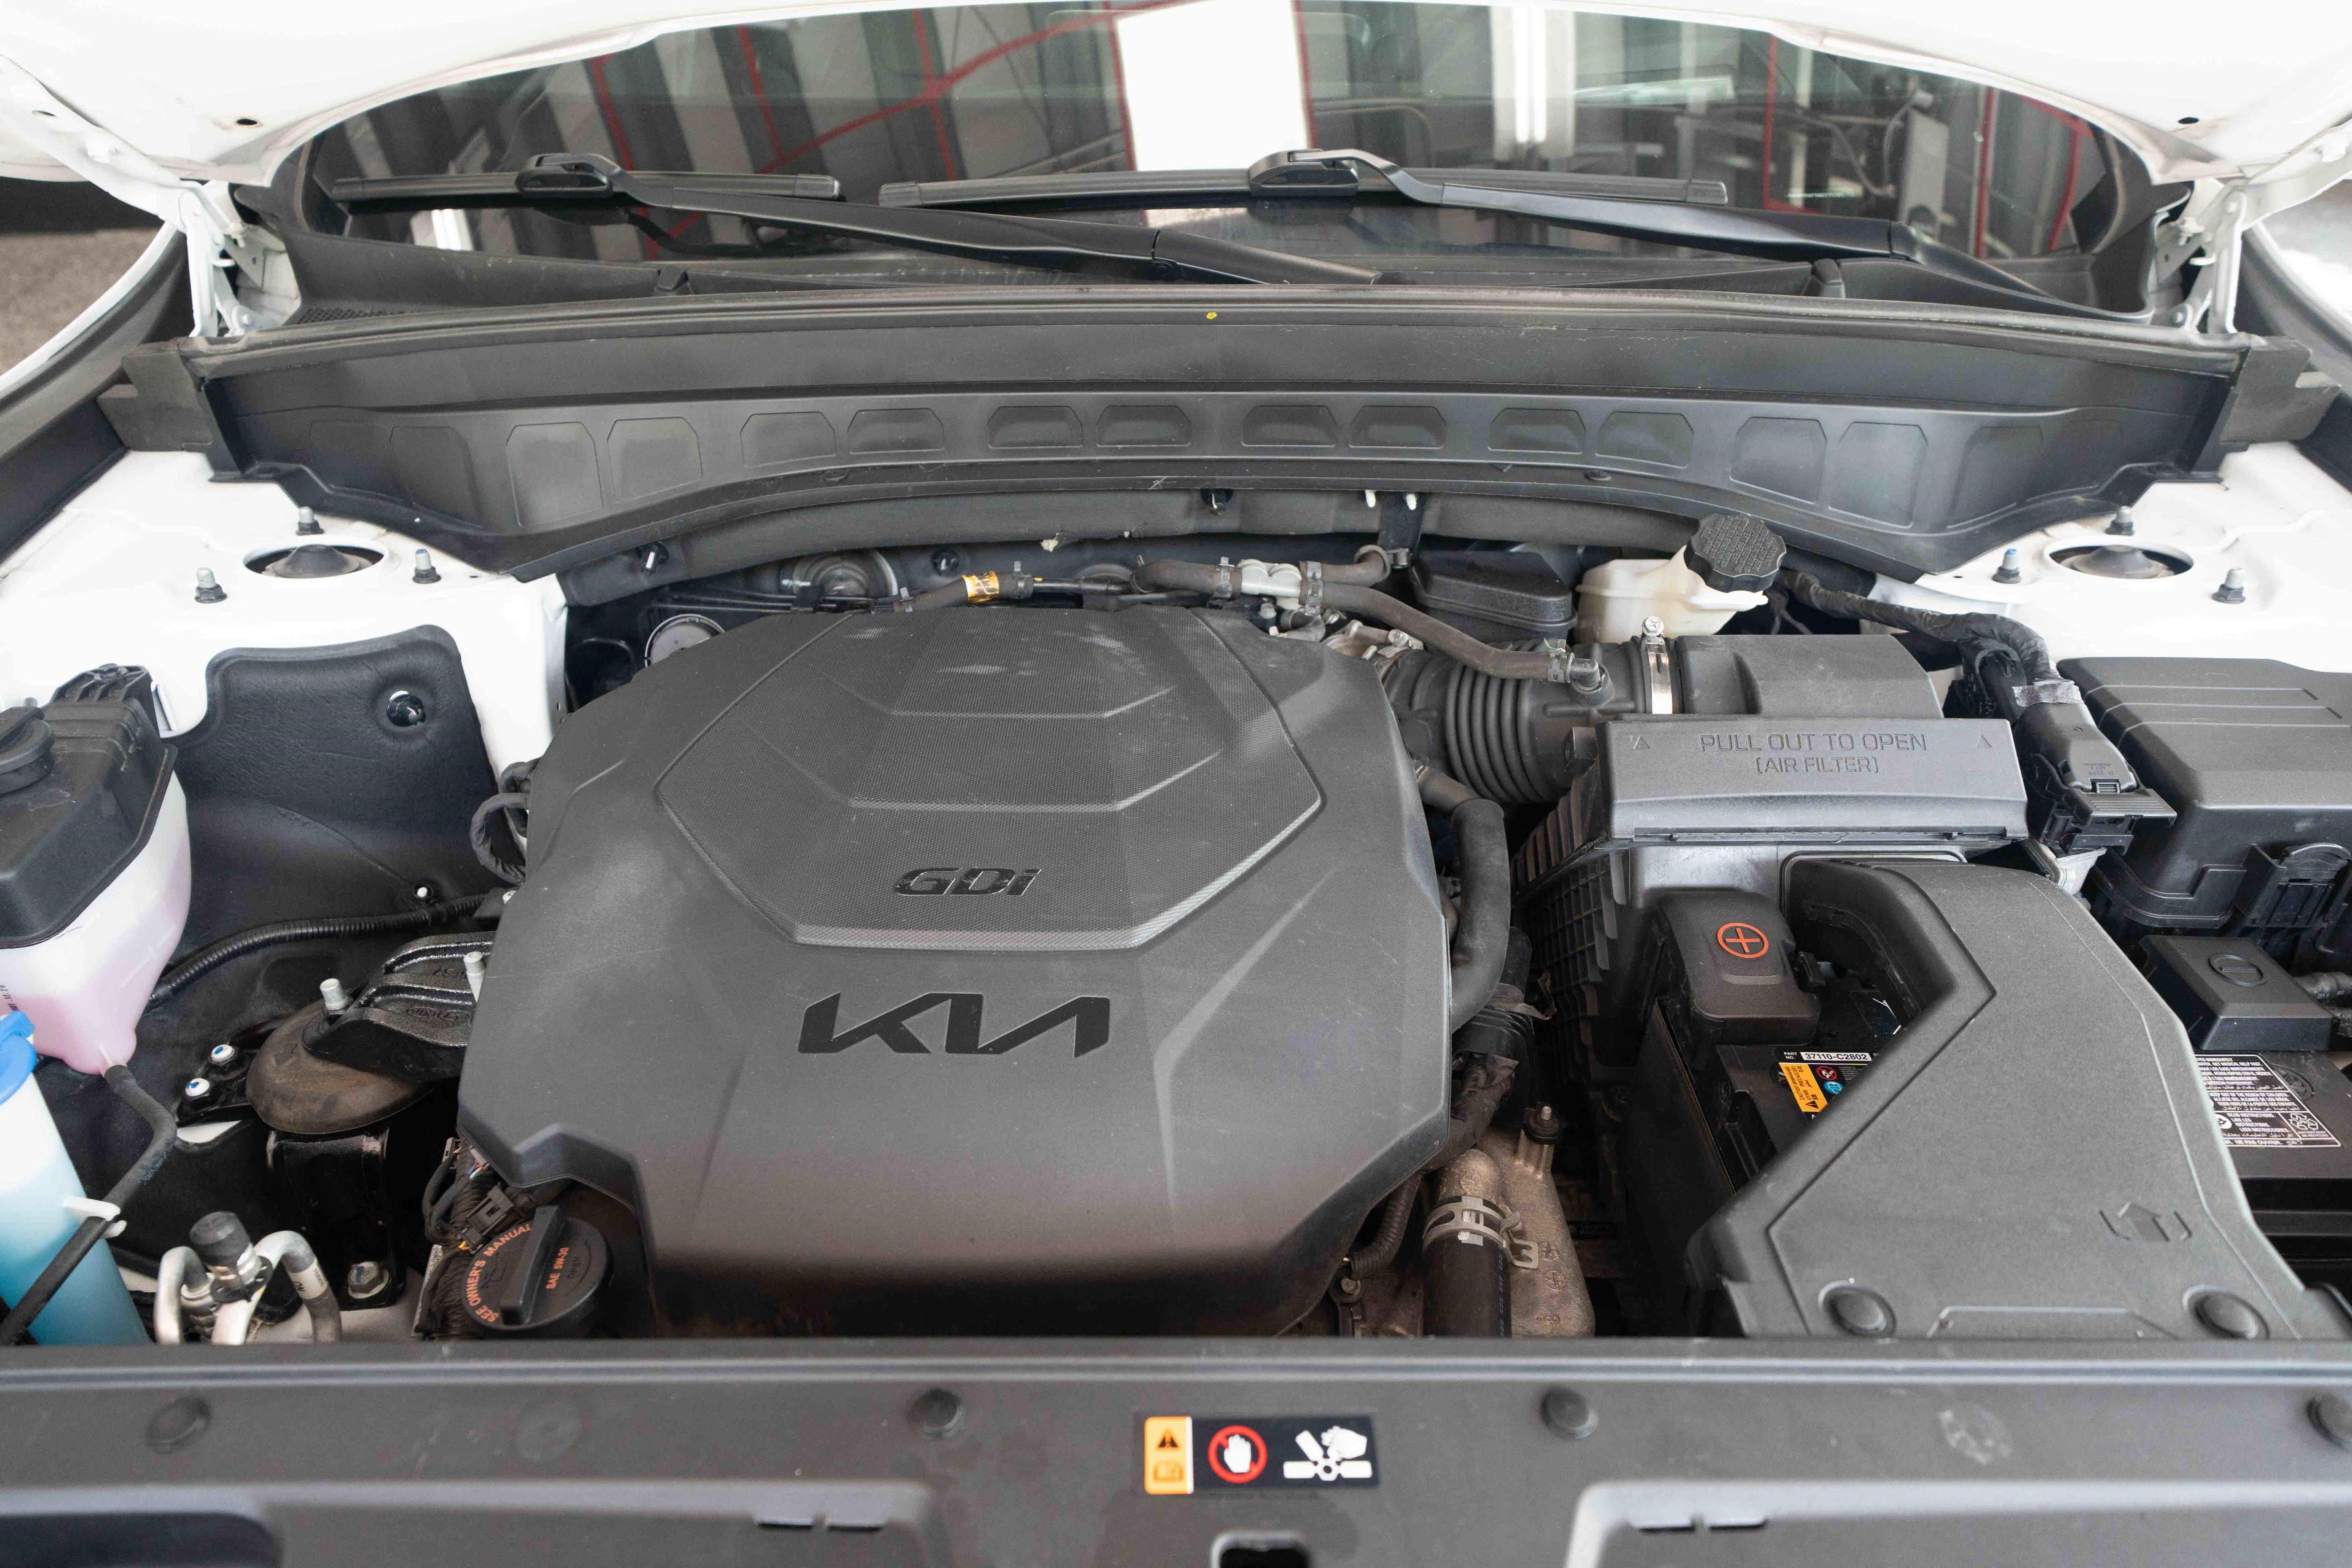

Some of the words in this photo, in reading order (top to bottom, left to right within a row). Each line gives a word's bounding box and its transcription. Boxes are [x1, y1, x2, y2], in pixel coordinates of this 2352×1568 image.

[1699, 733, 1762, 752] PULL
[1767, 733, 1815, 751] OUT
[1821, 733, 1854, 751] TO
[1862, 733, 1927, 751] OPEN
[895, 867, 1042, 896] GDi
[797, 991, 1111, 1059] KIA
[483, 1224, 532, 1257] MANUAL
[466, 1260, 487, 1307] OWNER'S
[545, 1272, 561, 1290] SAE
[553, 1247, 570, 1270] 5W-30
[474, 1305, 500, 1323] SEE
